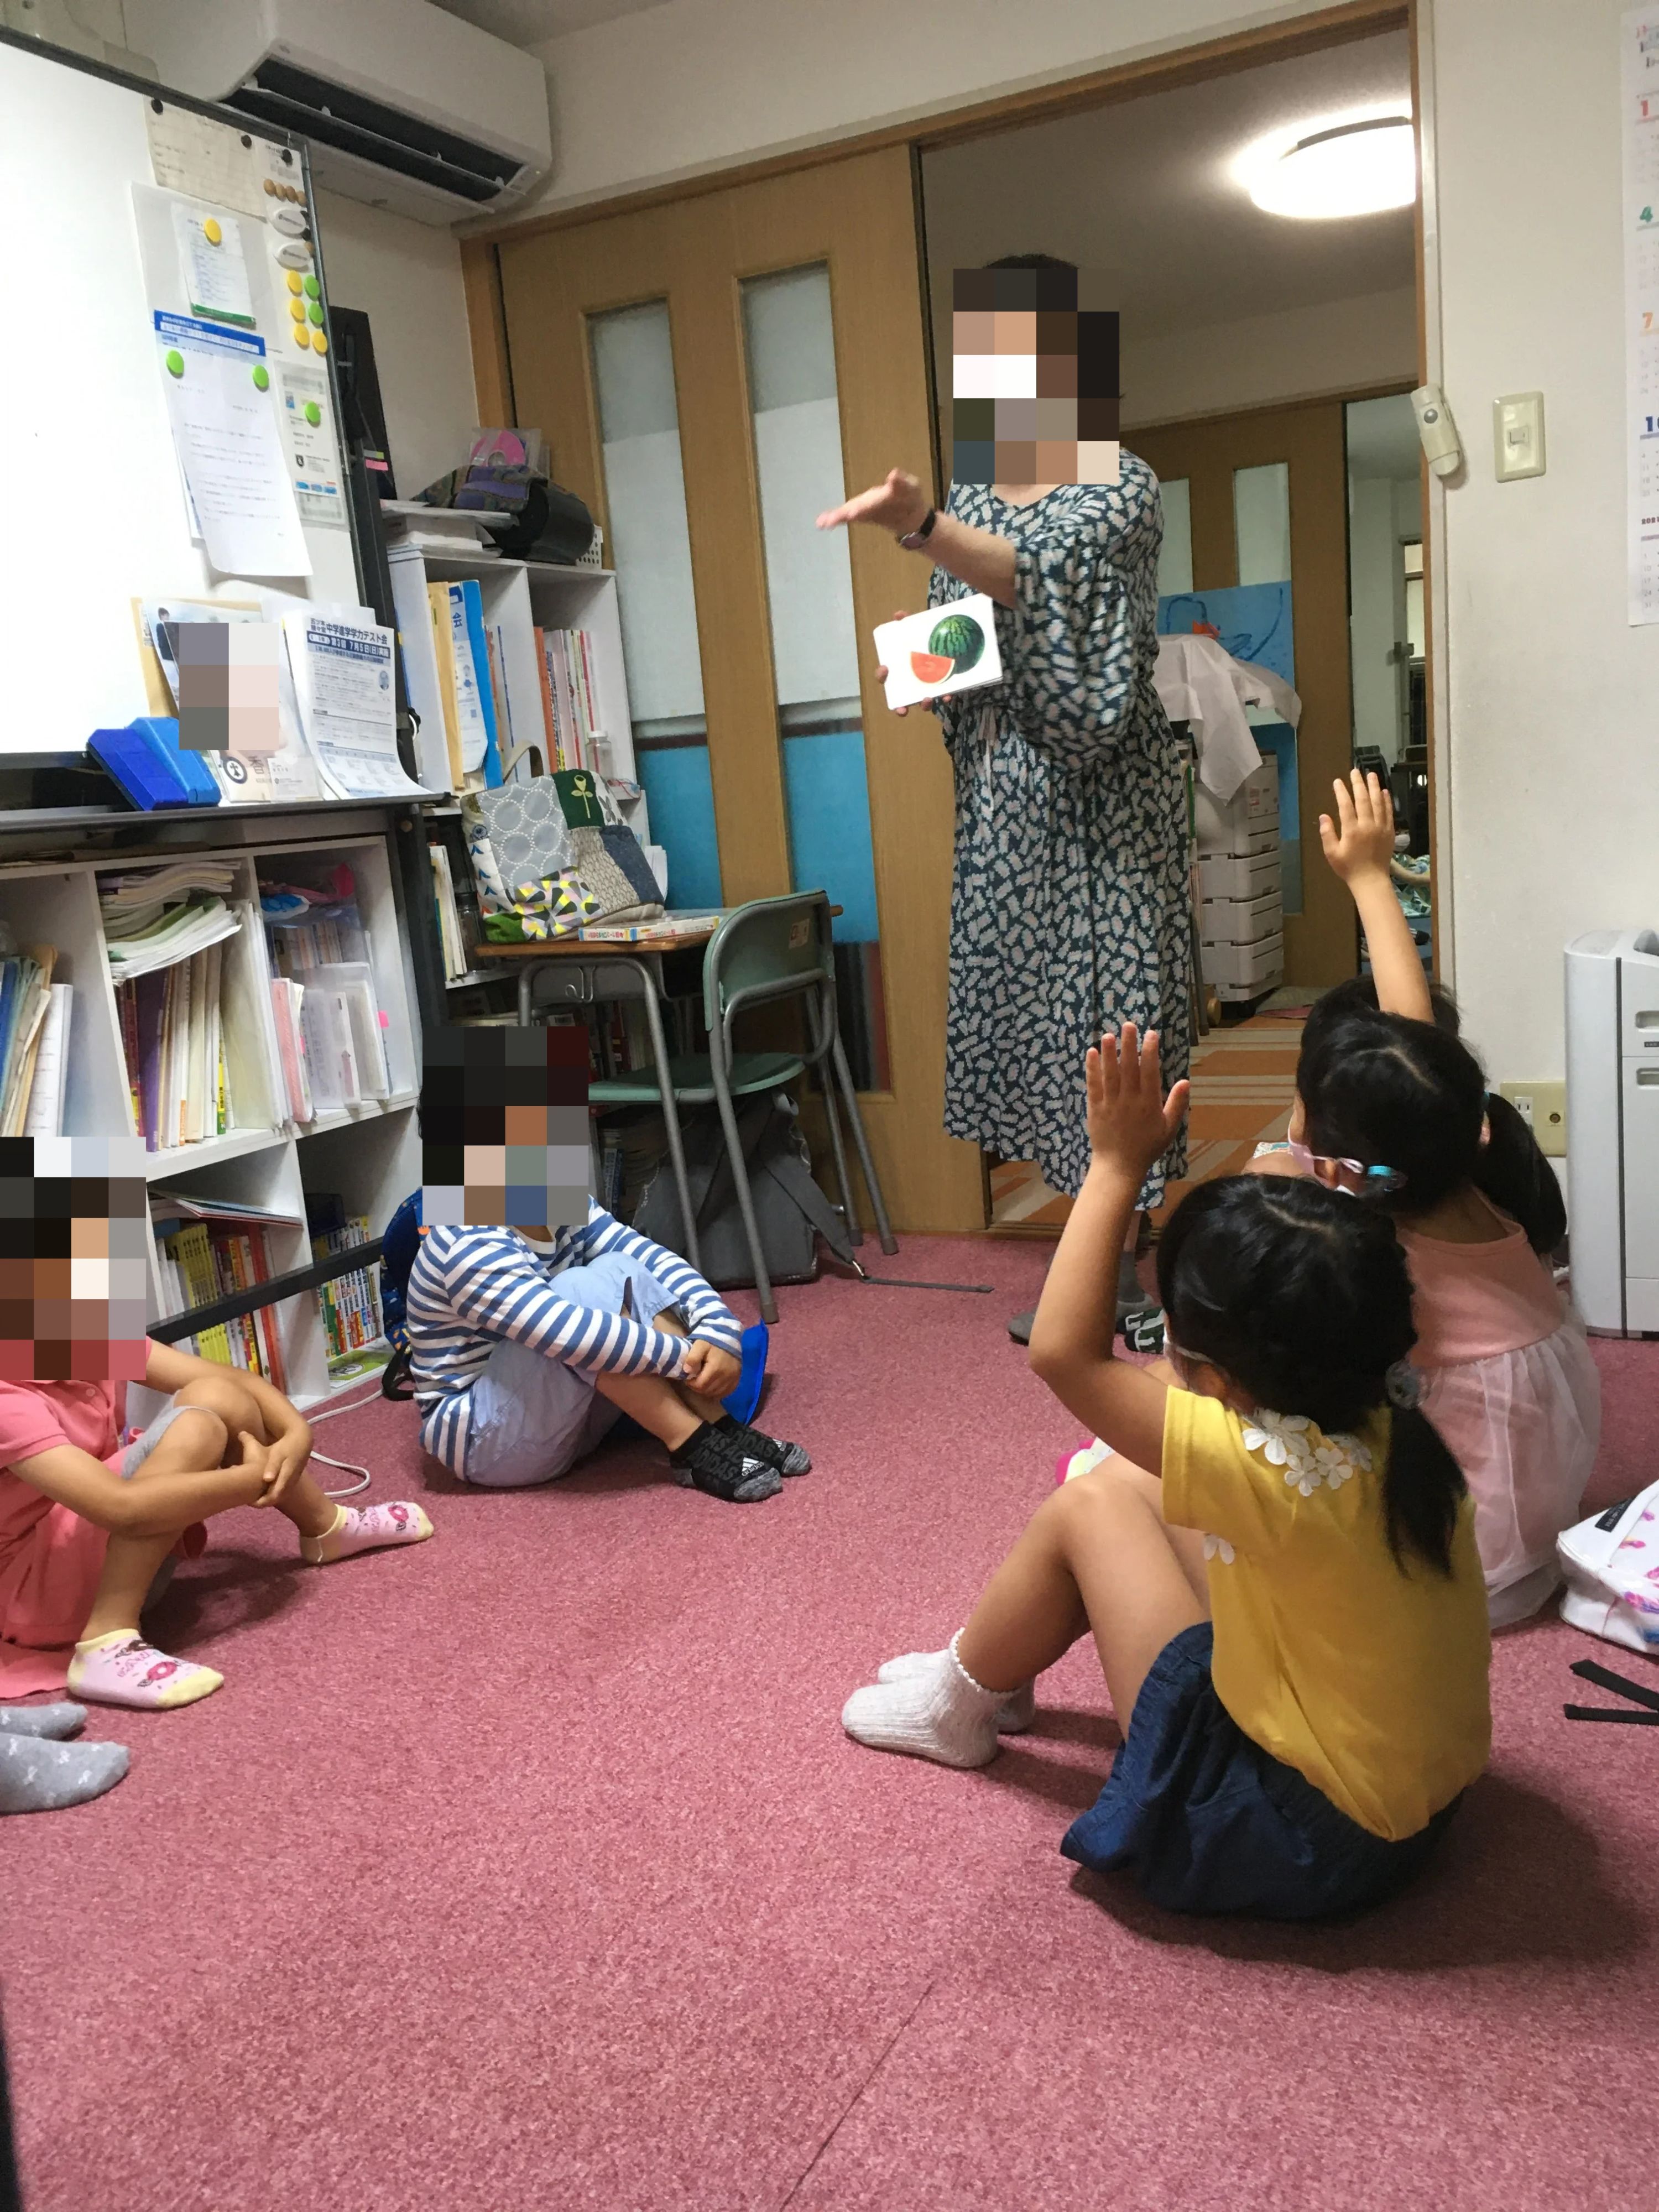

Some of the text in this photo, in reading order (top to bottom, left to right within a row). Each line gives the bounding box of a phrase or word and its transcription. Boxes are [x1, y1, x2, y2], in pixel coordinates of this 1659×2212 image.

[1640, 206, 1653, 222] 4
[1642, 312, 1653, 328] 7
[326, 623, 387, 645] 中学進学学力テスト会
